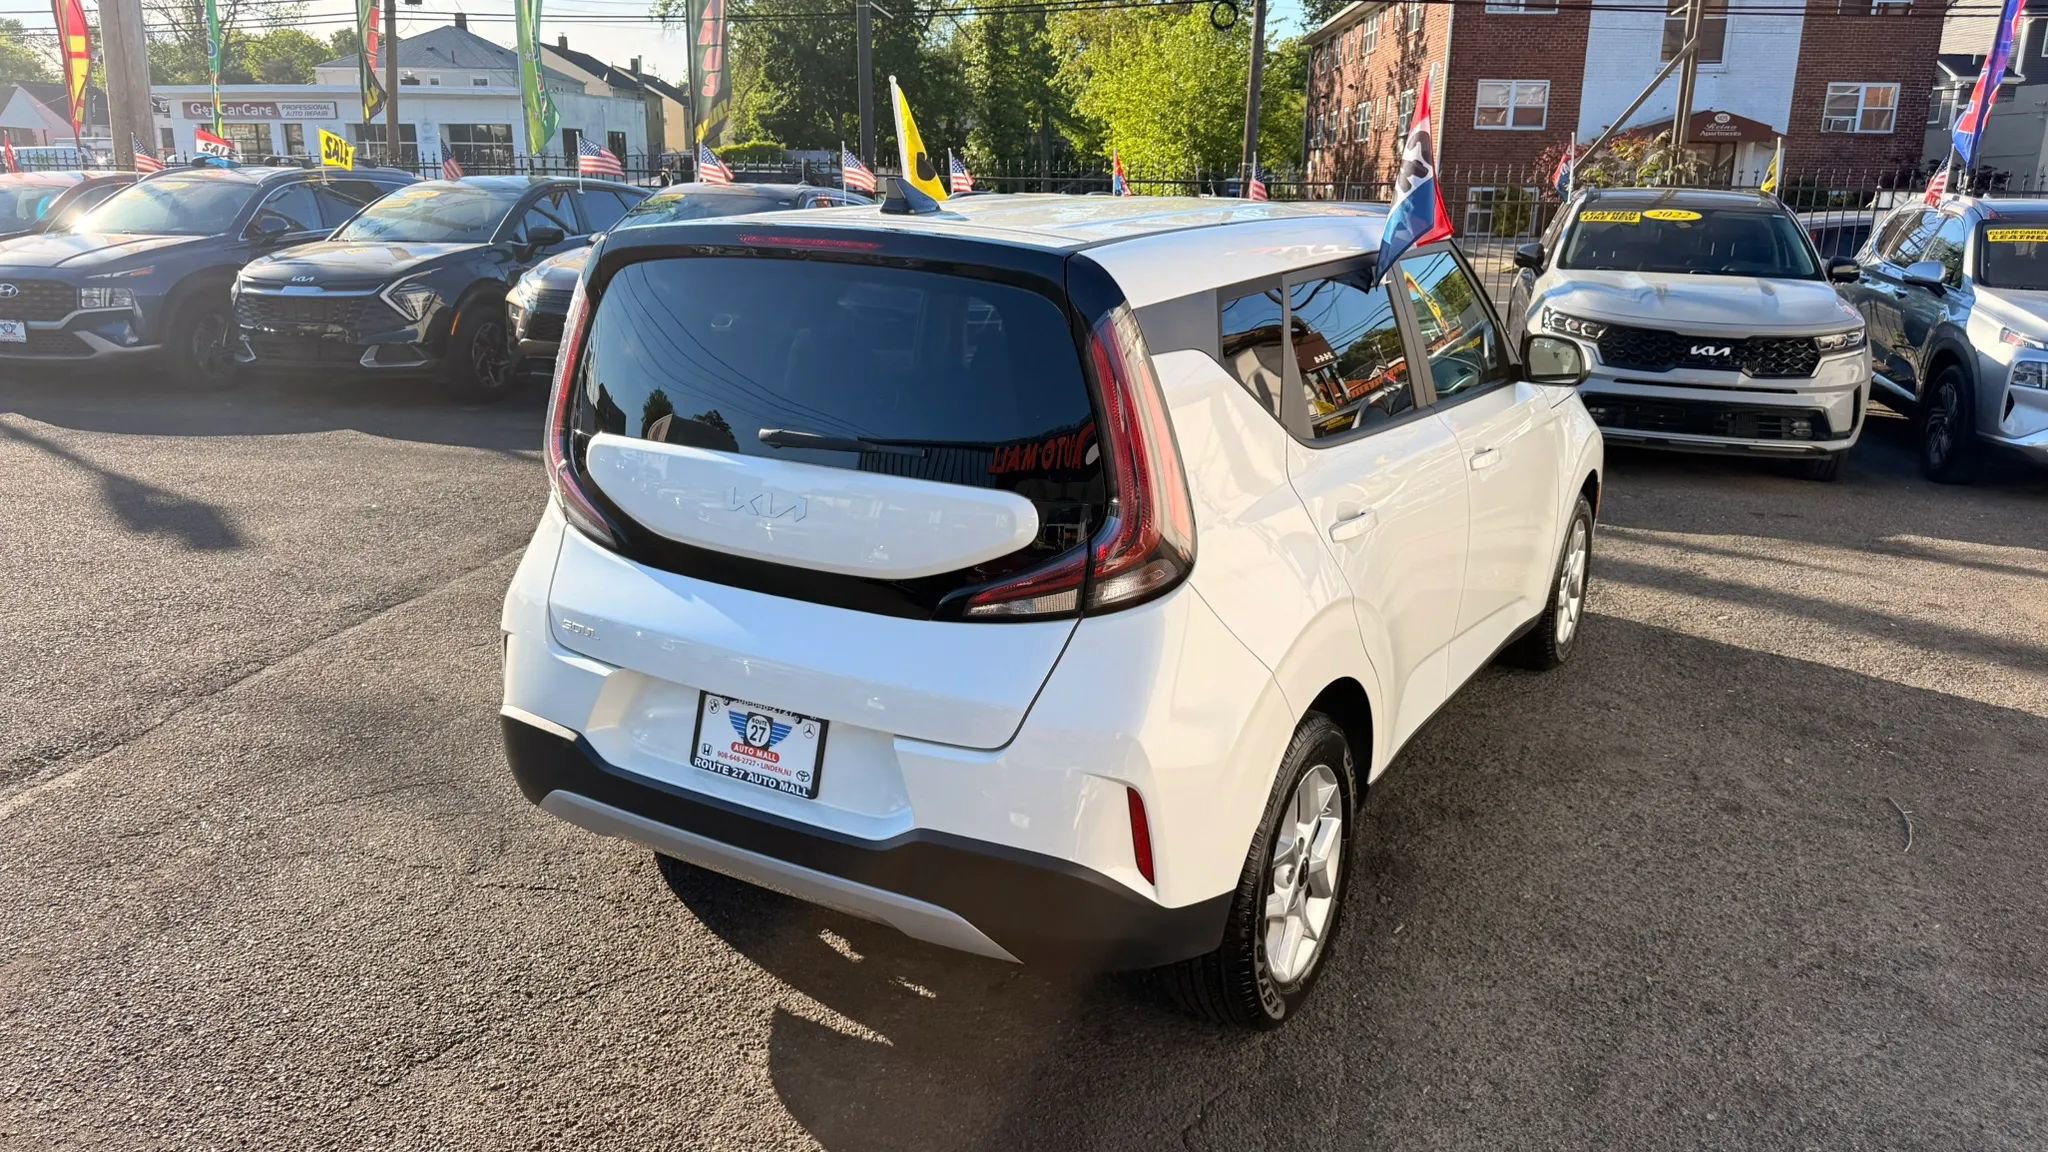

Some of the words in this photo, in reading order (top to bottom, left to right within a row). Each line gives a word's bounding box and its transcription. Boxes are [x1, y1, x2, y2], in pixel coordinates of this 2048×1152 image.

[220, 103, 273, 116] CarCare
[202, 142, 237, 160] SALE
[325, 135, 349, 166] SALE
[1653, 211, 1692, 219] 2022
[1690, 345, 1731, 357] KIA
[724, 486, 808, 523] KIA
[751, 717, 768, 727] ROUTE
[749, 724, 767, 743] 27
[733, 743, 753, 756] AUTO
[756, 749, 778, 762] MALL
[694, 757, 730, 775] ROUTE
[731, 767, 745, 779] 27
[747, 772, 777, 788] AUTO
[779, 781, 809, 798] MALL
